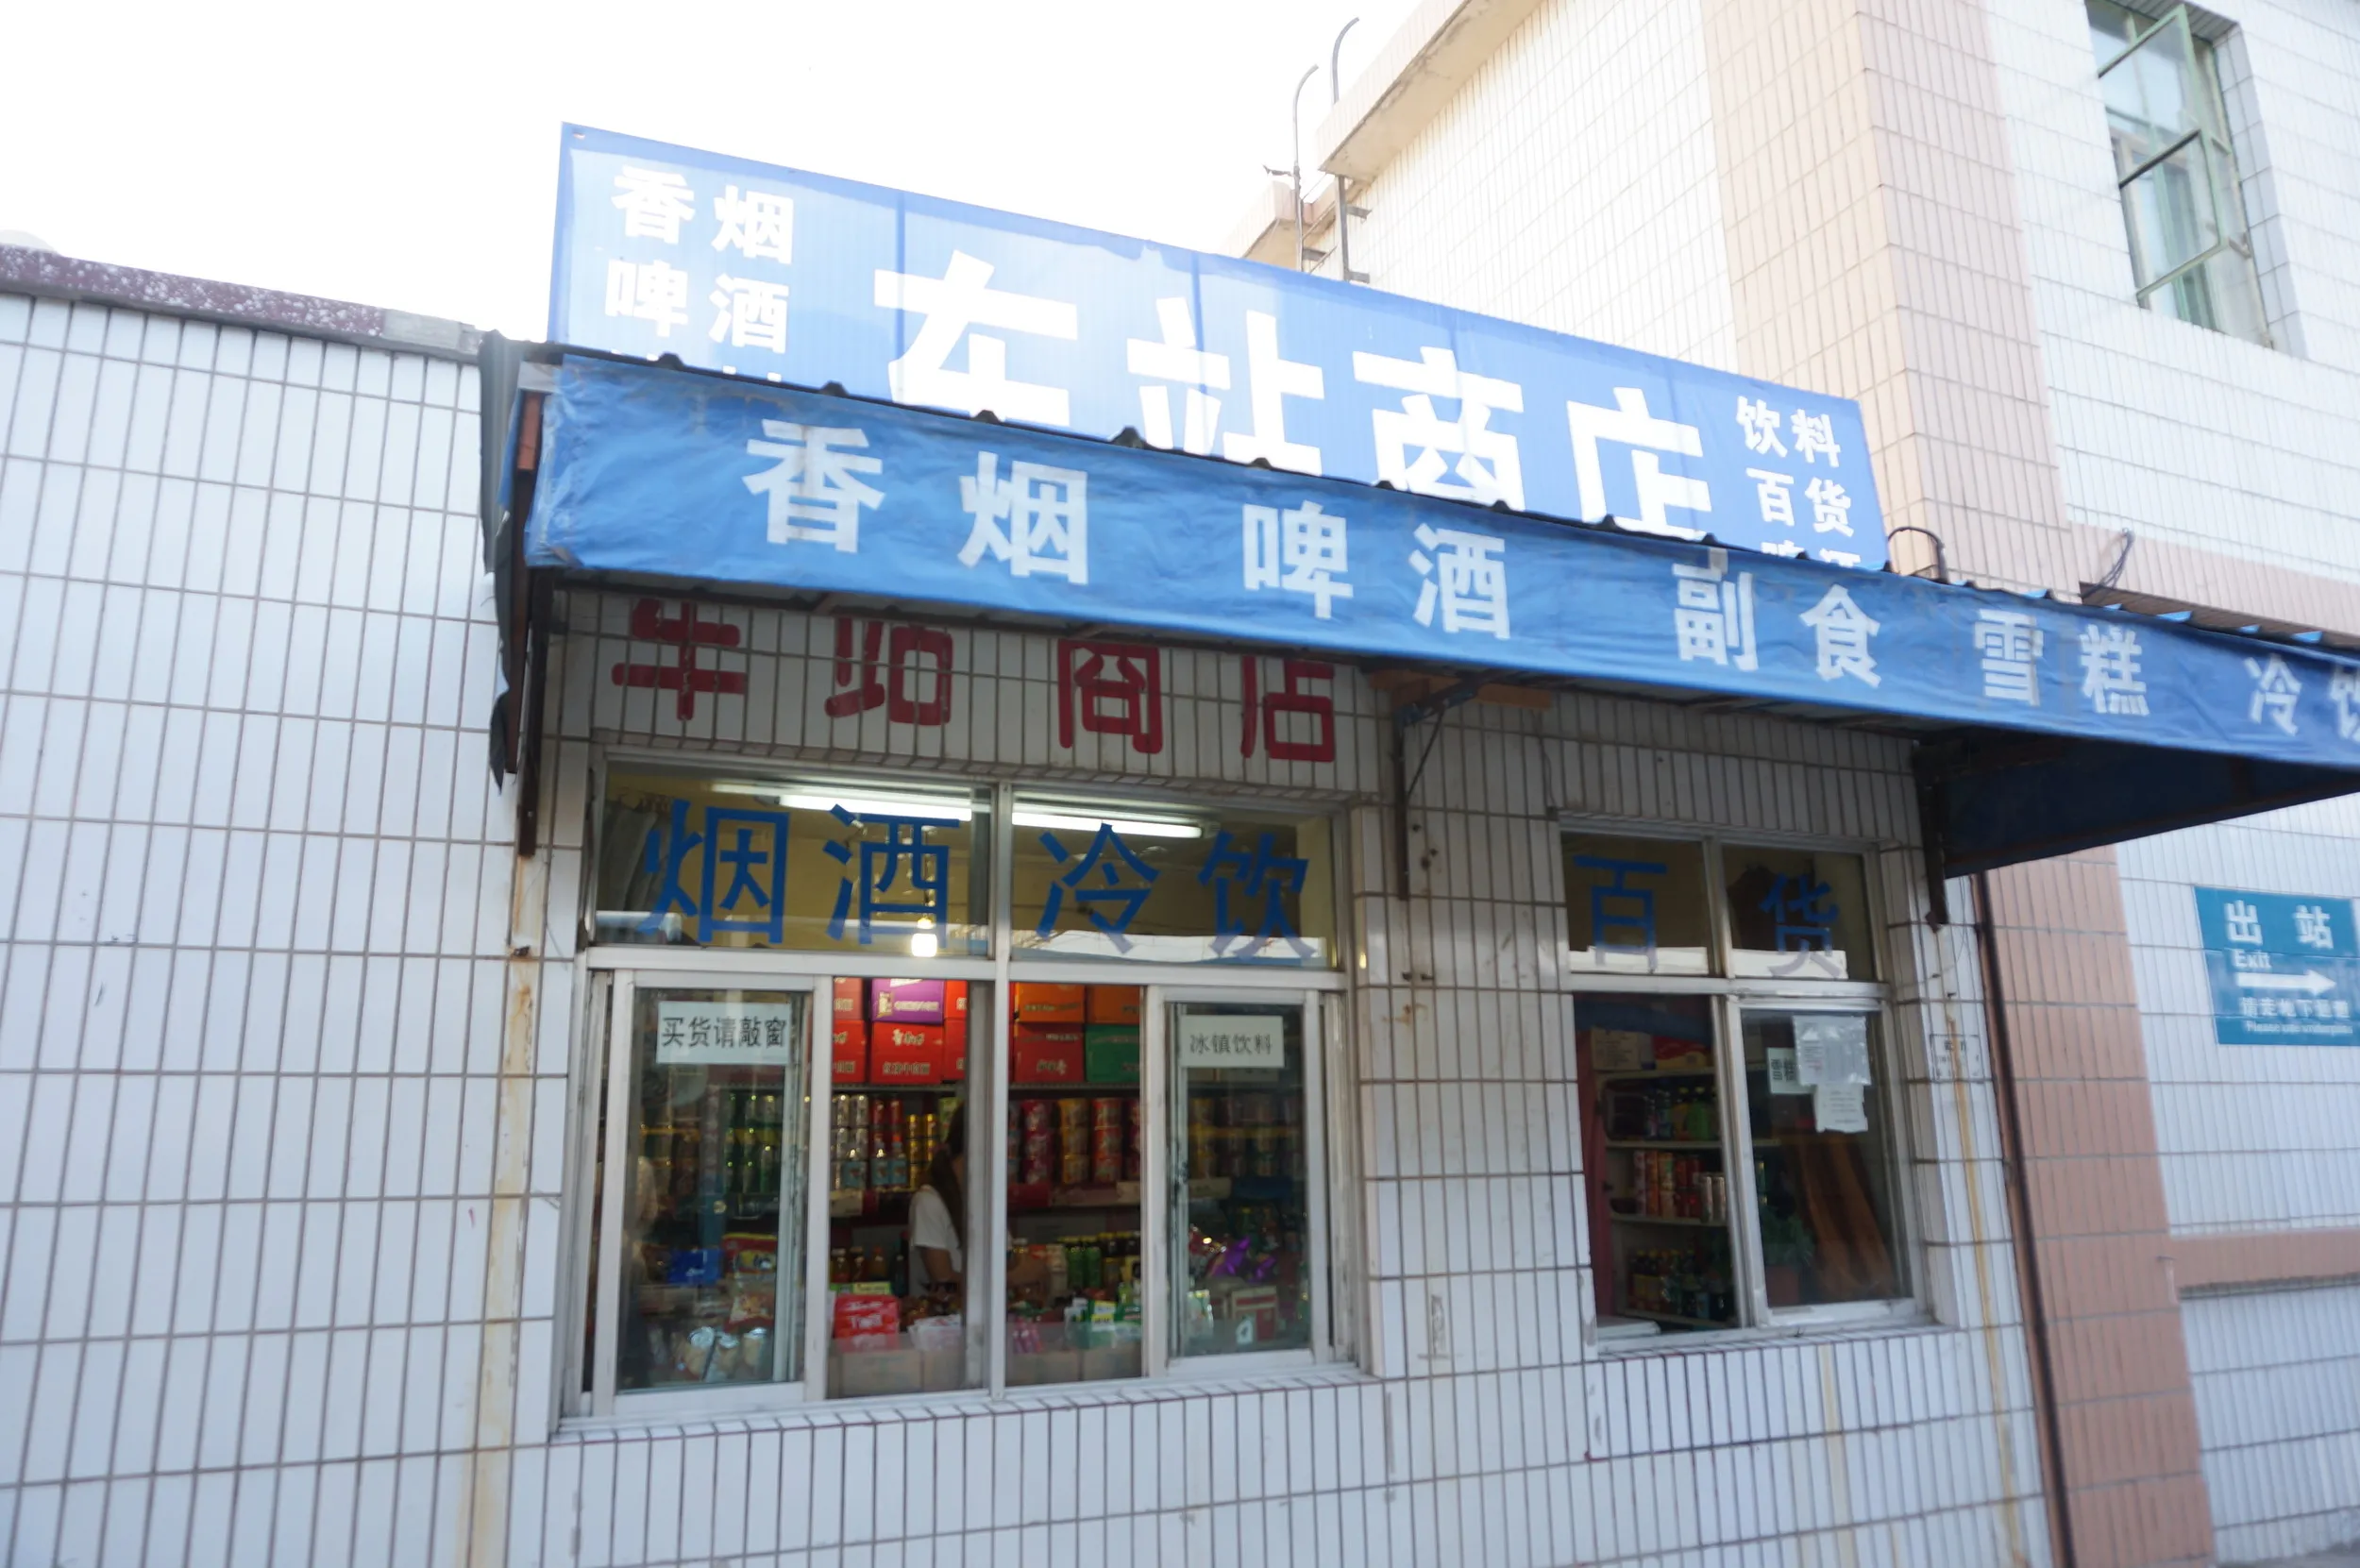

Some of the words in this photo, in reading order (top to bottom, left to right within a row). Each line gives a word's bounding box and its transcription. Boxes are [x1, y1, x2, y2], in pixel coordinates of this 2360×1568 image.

[611, 164, 795, 265] 香烟
[604, 259, 790, 355] 啤酒
[1736, 396, 1842, 468] 饮料
[1745, 466, 1855, 538] 百货
[742, 418, 1089, 586] 香烟
[1242, 500, 1511, 640] 啤酒
[1671, 563, 1881, 688] 副食
[1973, 608, 2150, 717] 雪糕
[638, 798, 960, 949] 烟酒
[1036, 822, 1316, 960] 冷饮
[1574, 855, 1844, 979] 百货
[2223, 900, 2335, 949] 出站
[2233, 948, 2272, 969] Exit
[662, 1015, 786, 1049] 买货请敲窗
